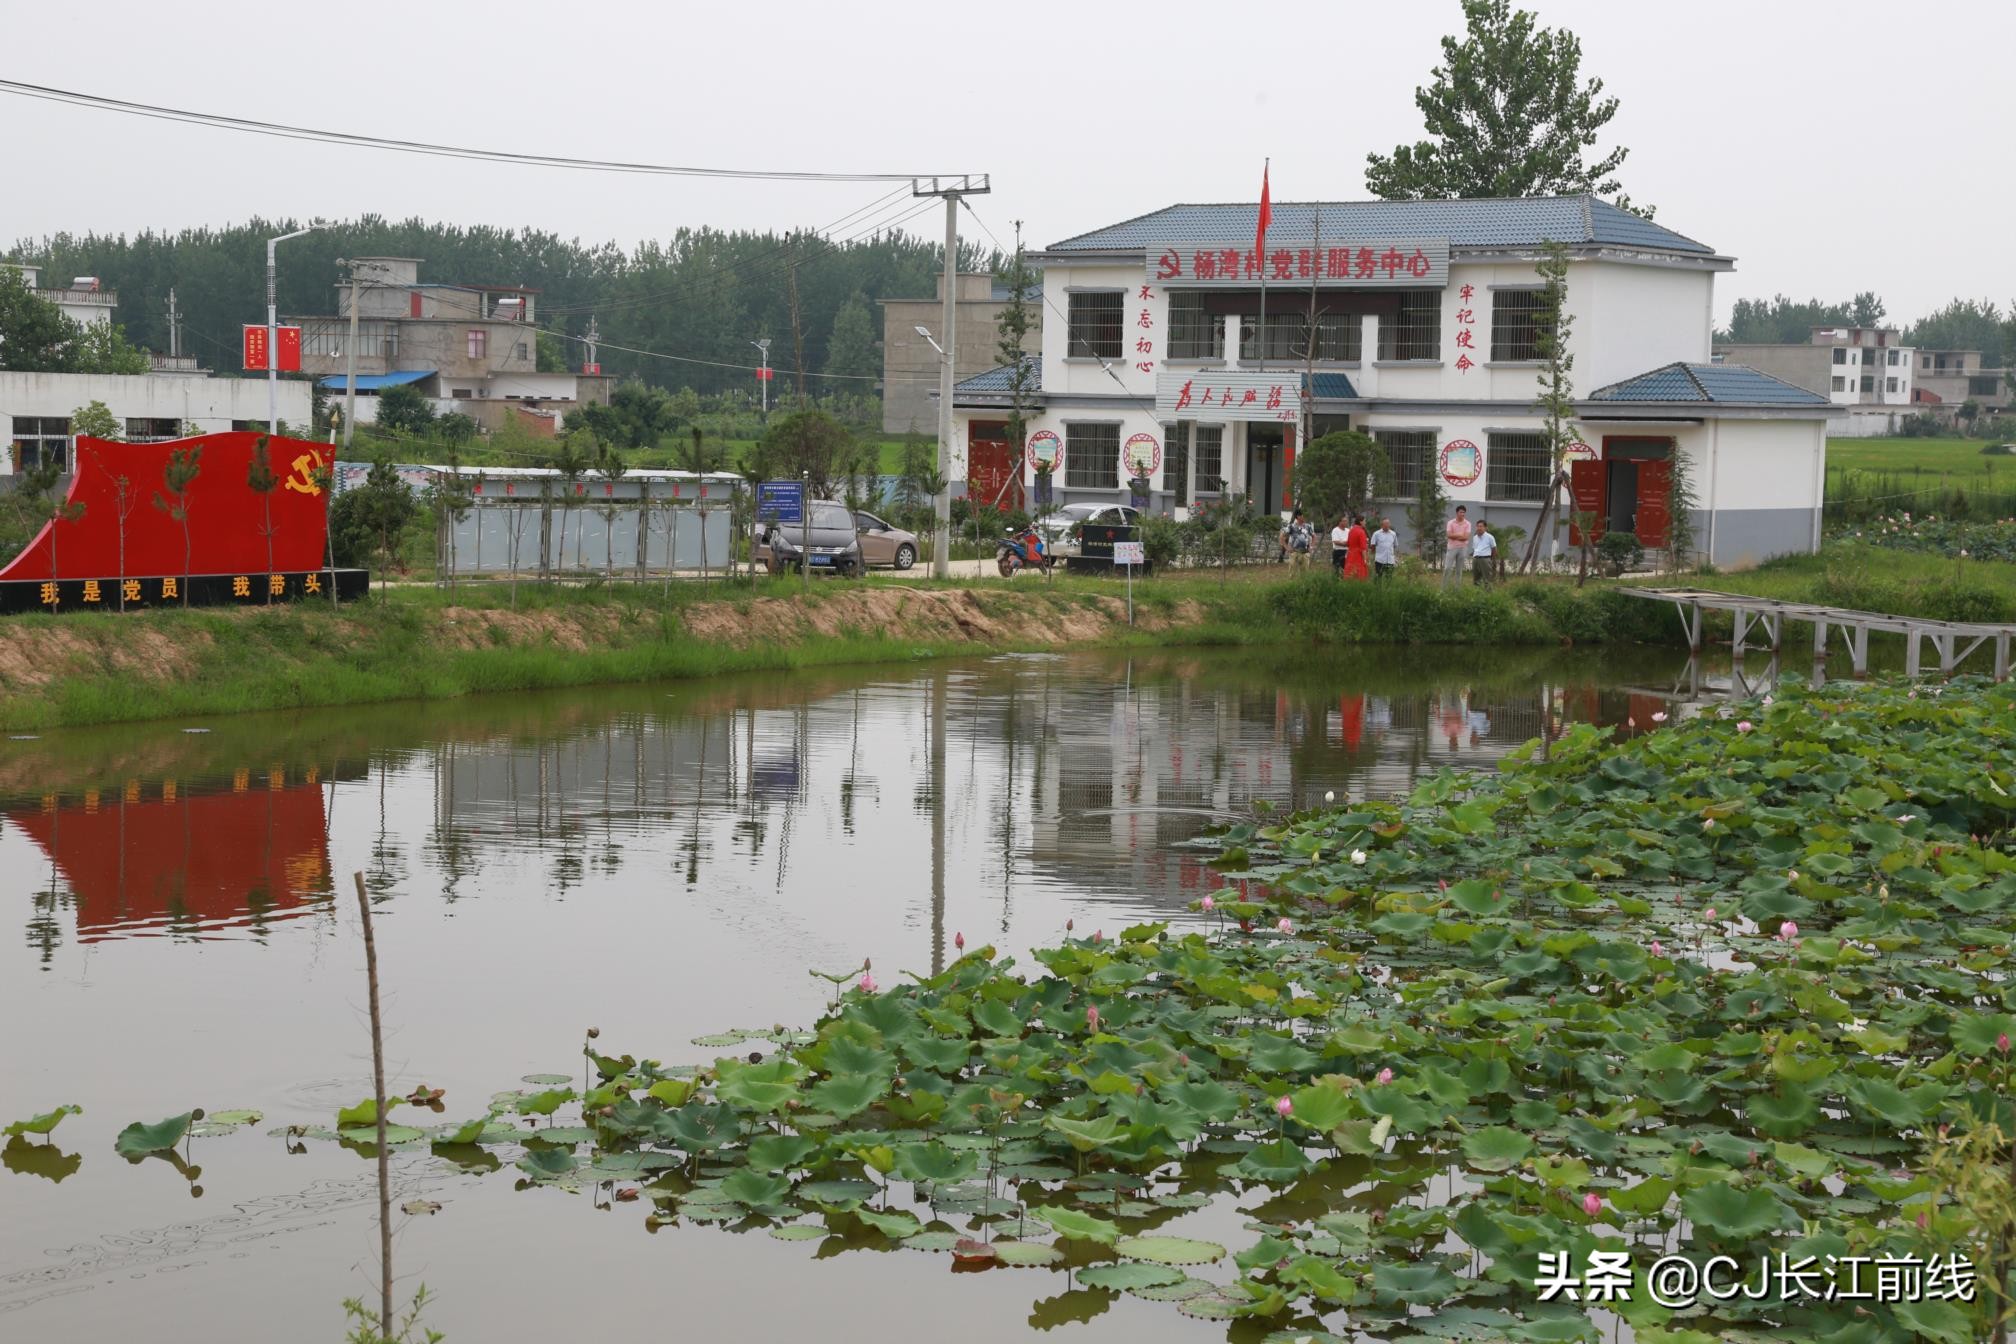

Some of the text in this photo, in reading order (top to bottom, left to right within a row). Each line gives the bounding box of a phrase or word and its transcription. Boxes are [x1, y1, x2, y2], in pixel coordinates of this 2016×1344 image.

[1135, 285, 1155, 373] 不忘初心
[1454, 284, 1476, 375] 牢记使命
[40, 573, 322, 605] 我是党员 我带头
